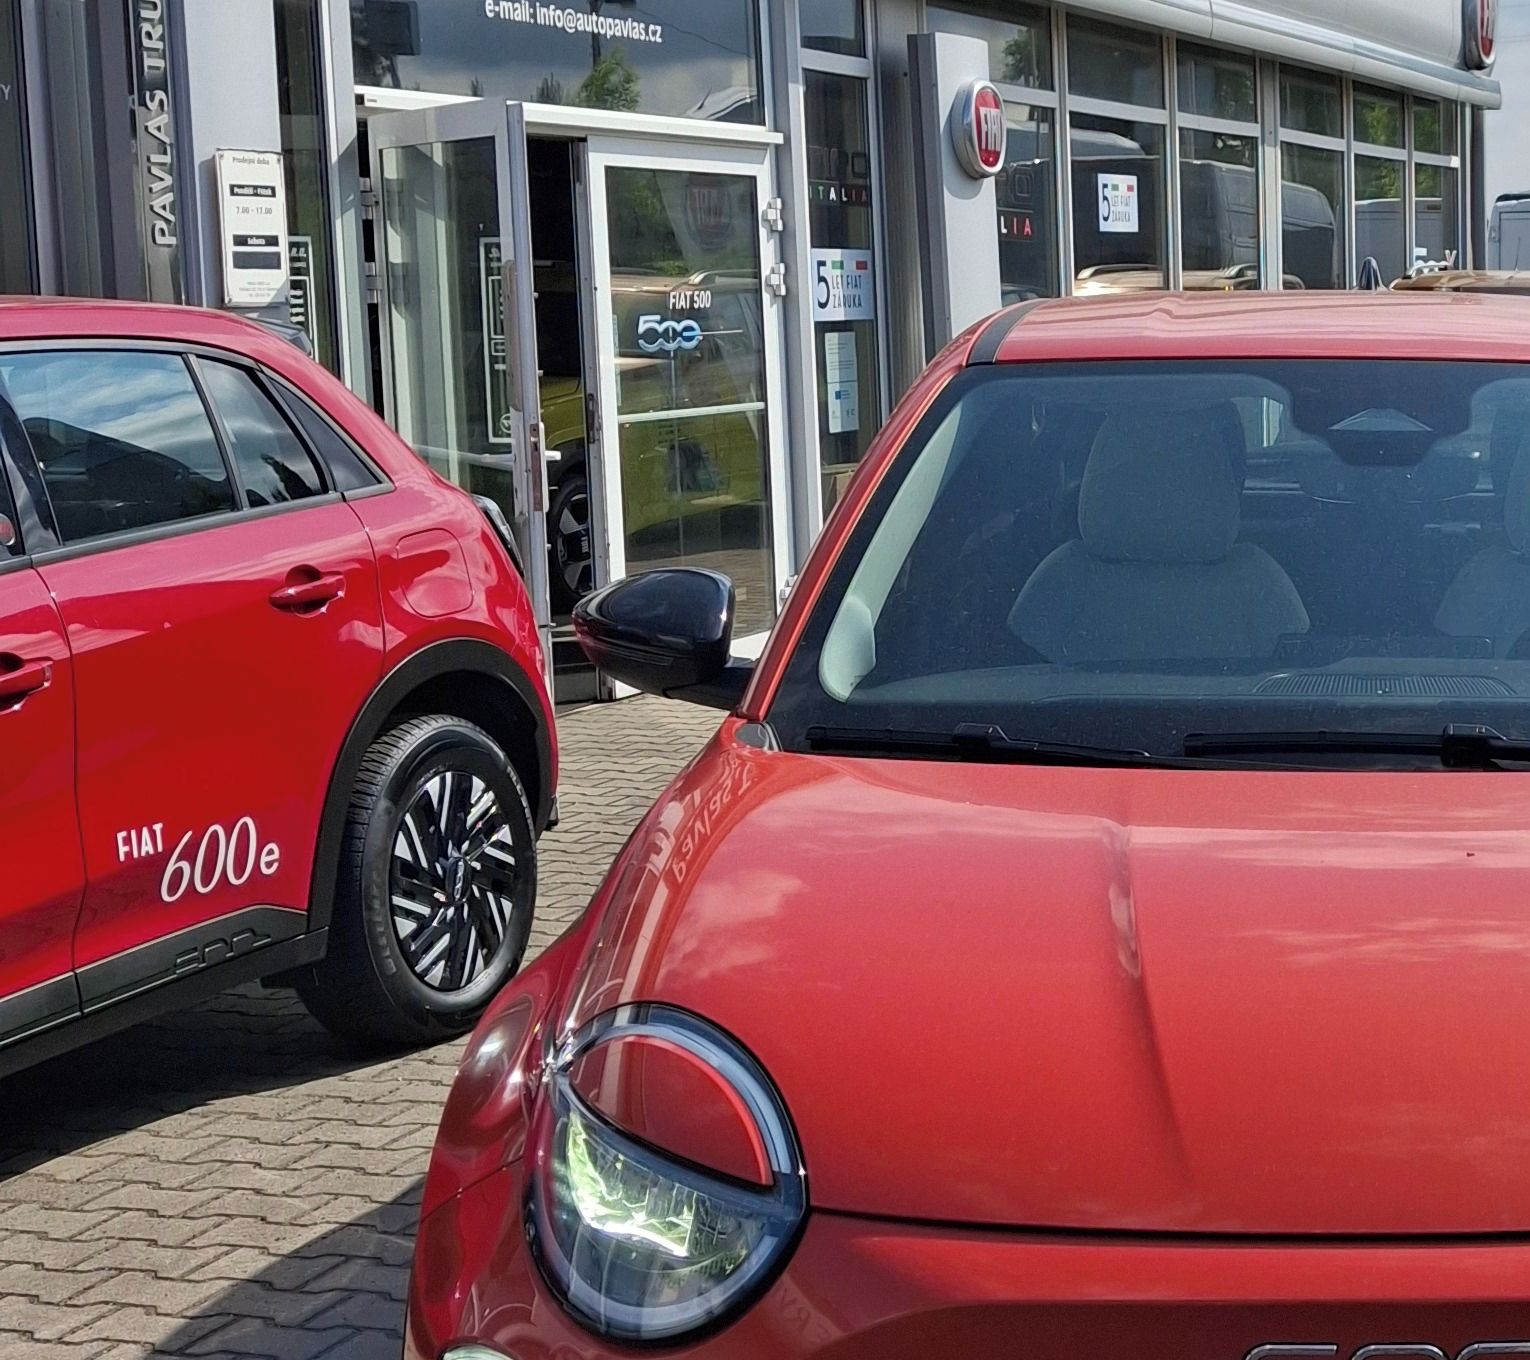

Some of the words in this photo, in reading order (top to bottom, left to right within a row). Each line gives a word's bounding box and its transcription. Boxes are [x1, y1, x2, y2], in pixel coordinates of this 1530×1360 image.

[535, 1, 663, 43] info@autopavlas.cz
[143, 89, 178, 248] PAVLAS
[808, 186, 869, 202] ITALIA
[1101, 183, 1111, 223] 5
[669, 290, 693, 311] FIAT
[693, 290, 711, 309] 500
[816, 260, 831, 310] 5
[832, 274, 845, 290] LET
[846, 274, 863, 290] FIAT
[115, 821, 166, 863] FIAT
